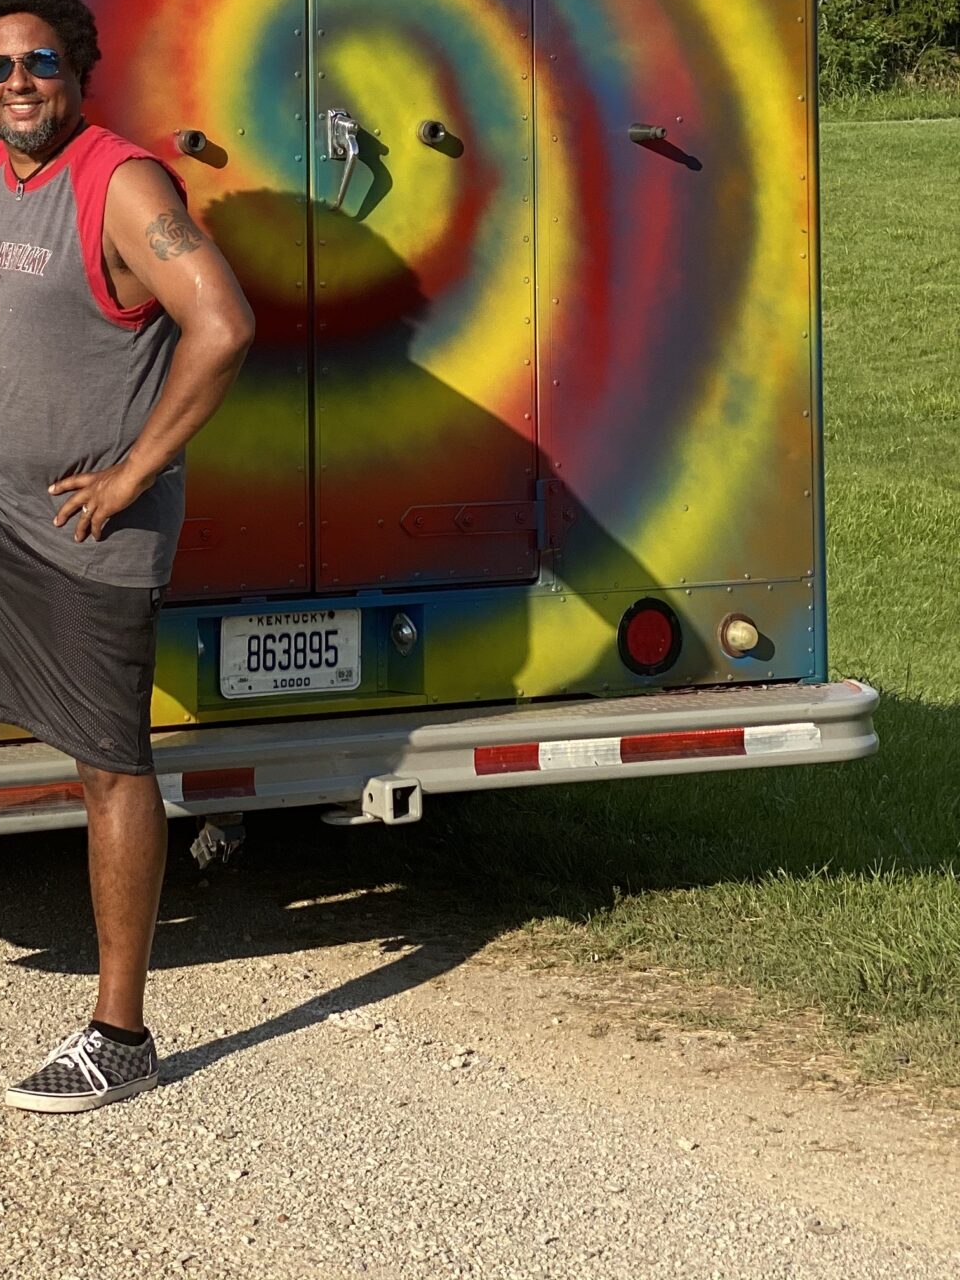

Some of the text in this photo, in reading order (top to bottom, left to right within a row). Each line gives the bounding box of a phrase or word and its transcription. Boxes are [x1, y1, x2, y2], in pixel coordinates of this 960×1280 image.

[257, 612, 327, 626] KENTUCKY
[247, 630, 339, 673] 863895
[273, 677, 311, 689] 10000
